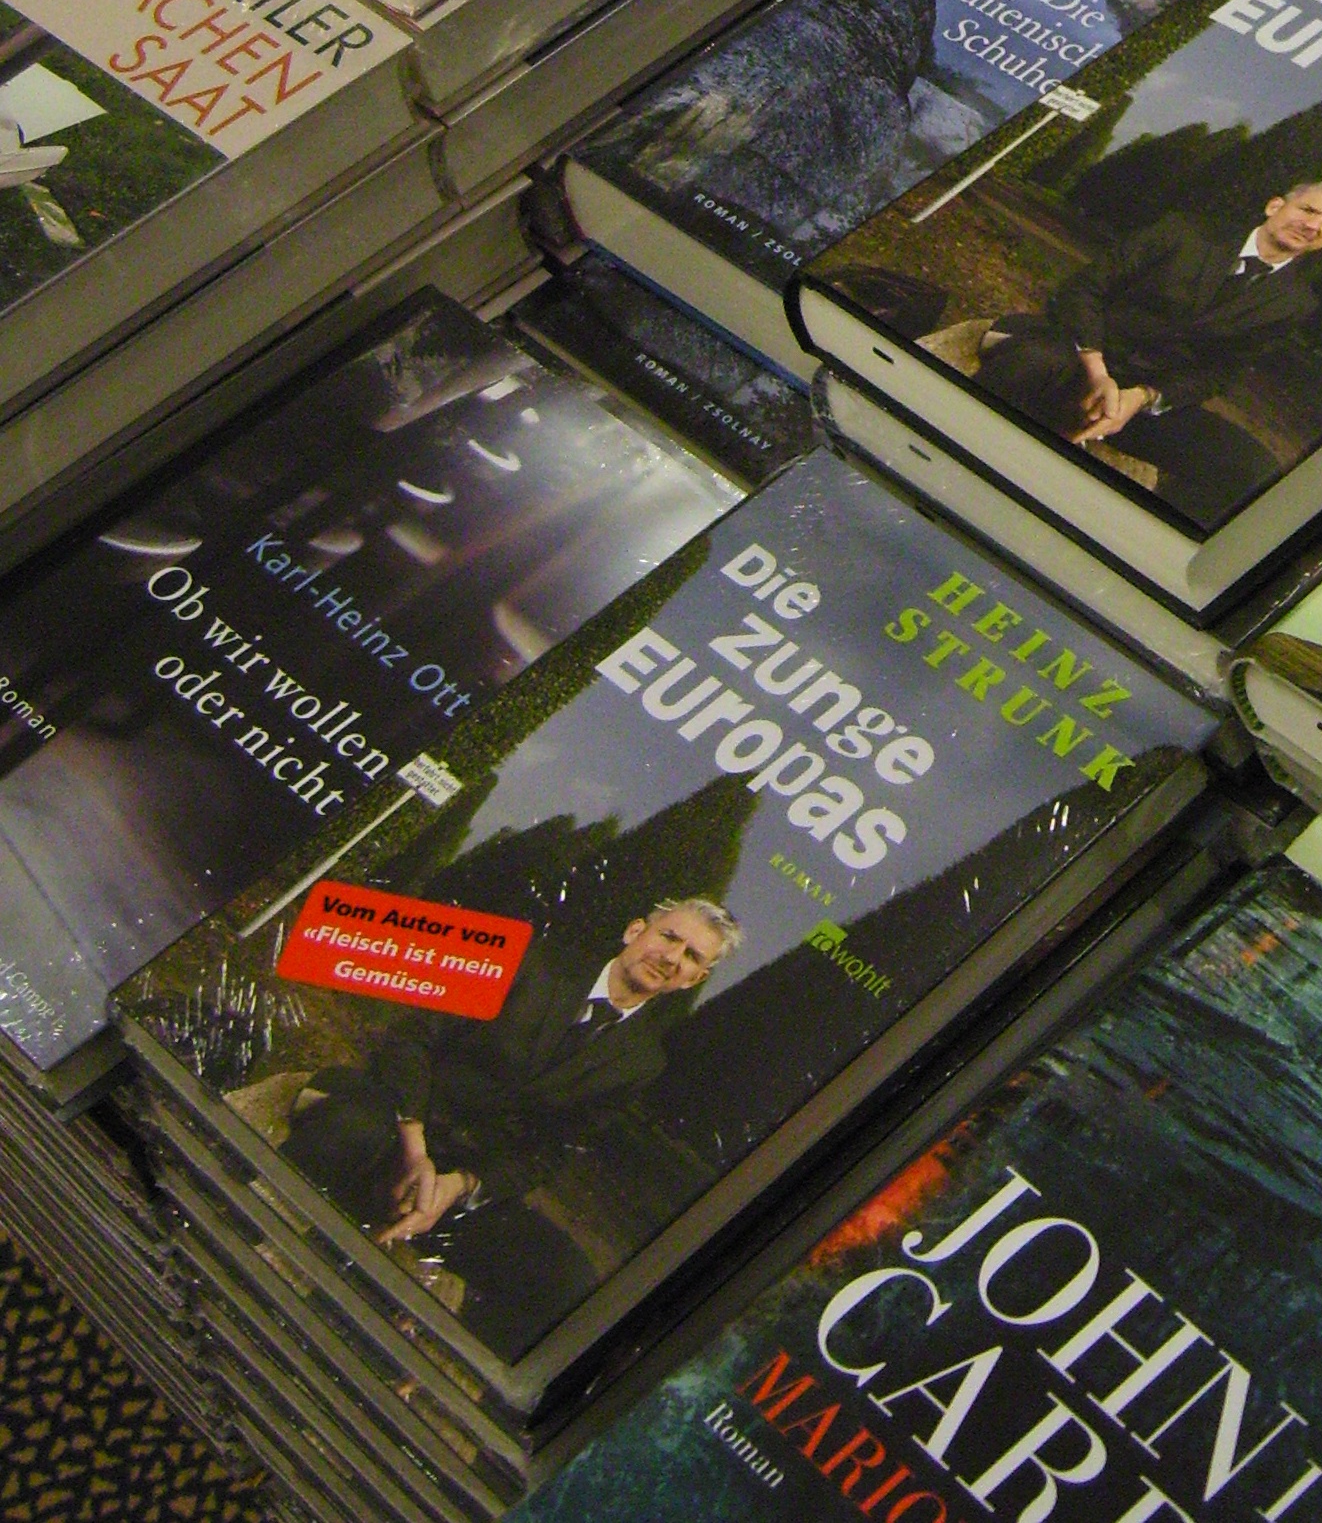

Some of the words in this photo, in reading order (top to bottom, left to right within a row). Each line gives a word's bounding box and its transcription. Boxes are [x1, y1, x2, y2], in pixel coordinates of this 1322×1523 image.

[106, 33, 269, 138] SAAT
[693, 192, 750, 232] ROMAN
[634, 352, 690, 395] ROMAN
[702, 401, 772, 452] ZSOLNAY
[245, 531, 412, 671] Karl-Heinz
[408, 662, 475, 719] Ott
[718, 542, 823, 620] Die
[146, 564, 207, 623] Ob
[204, 618, 273, 673] wir
[263, 664, 394, 782] wollen
[926, 571, 1134, 721] HEINZ
[153, 655, 246, 740] oder
[235, 726, 354, 818] nicht
[884, 606, 1138, 794] STRUNK
[319, 894, 379, 926] Vom
[379, 905, 456, 941] Autor
[460, 924, 508, 950] von
[768, 852, 838, 907] ROMAN
[303, 922, 401, 963] «Fleisch
[403, 941, 439, 967] ist
[442, 949, 506, 982] mein
[333, 956, 448, 1000] Gemüse»
[900, 1164, 1309, 1504] JOHN
[702, 1400, 787, 1489] Roman
